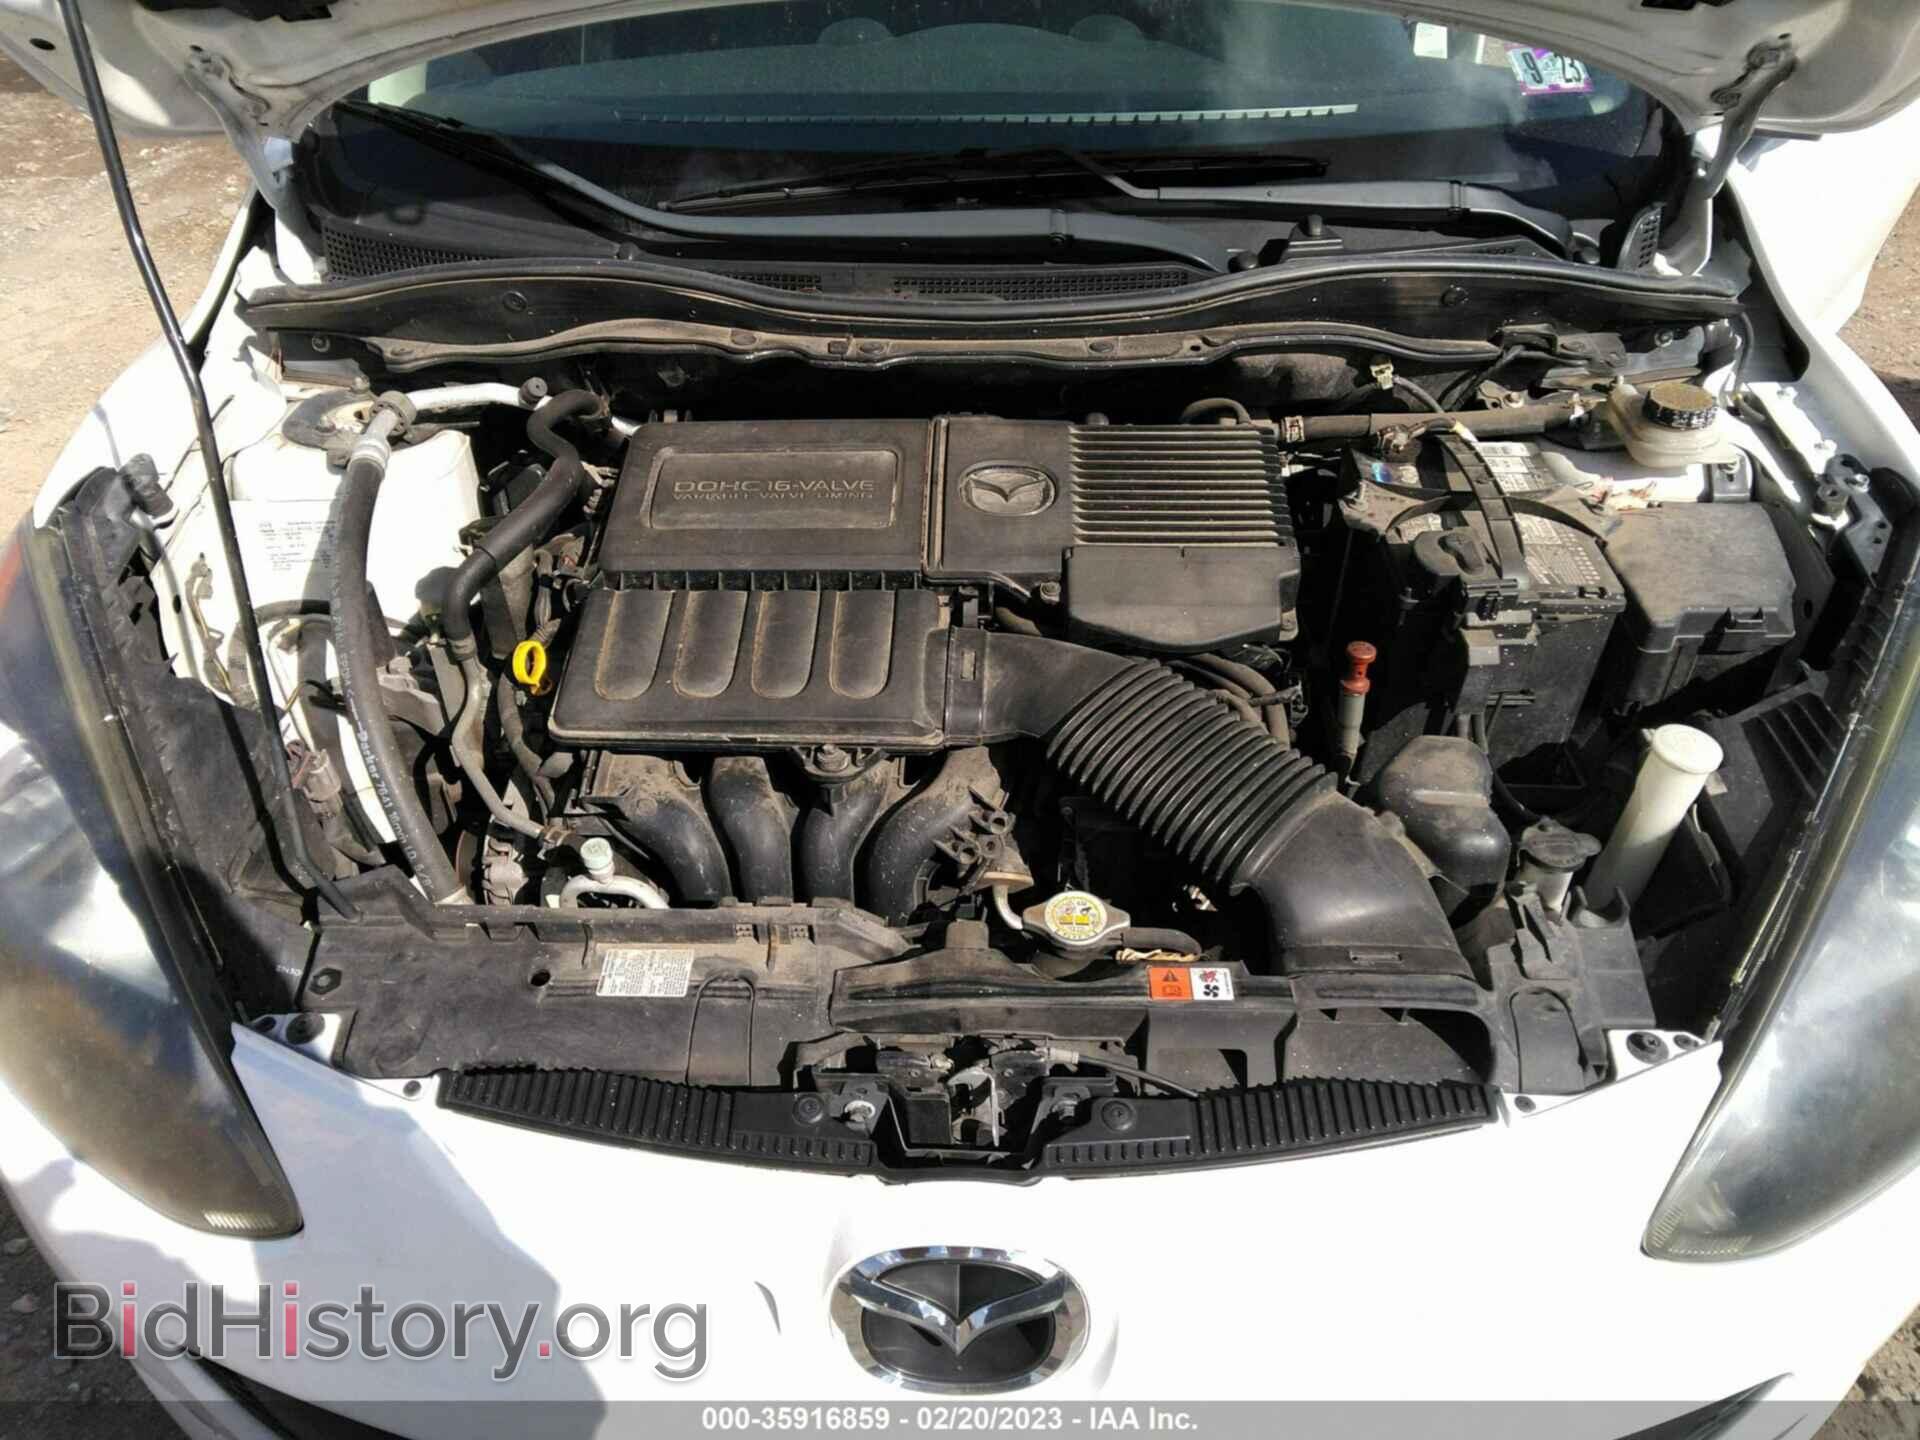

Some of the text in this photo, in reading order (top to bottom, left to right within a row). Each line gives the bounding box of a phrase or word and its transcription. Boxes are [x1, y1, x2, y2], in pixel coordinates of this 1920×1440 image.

[1522, 52, 1543, 84] 9
[673, 480, 875, 493] DOHC 16-VALVE
[357, 728, 380, 779] Parker
